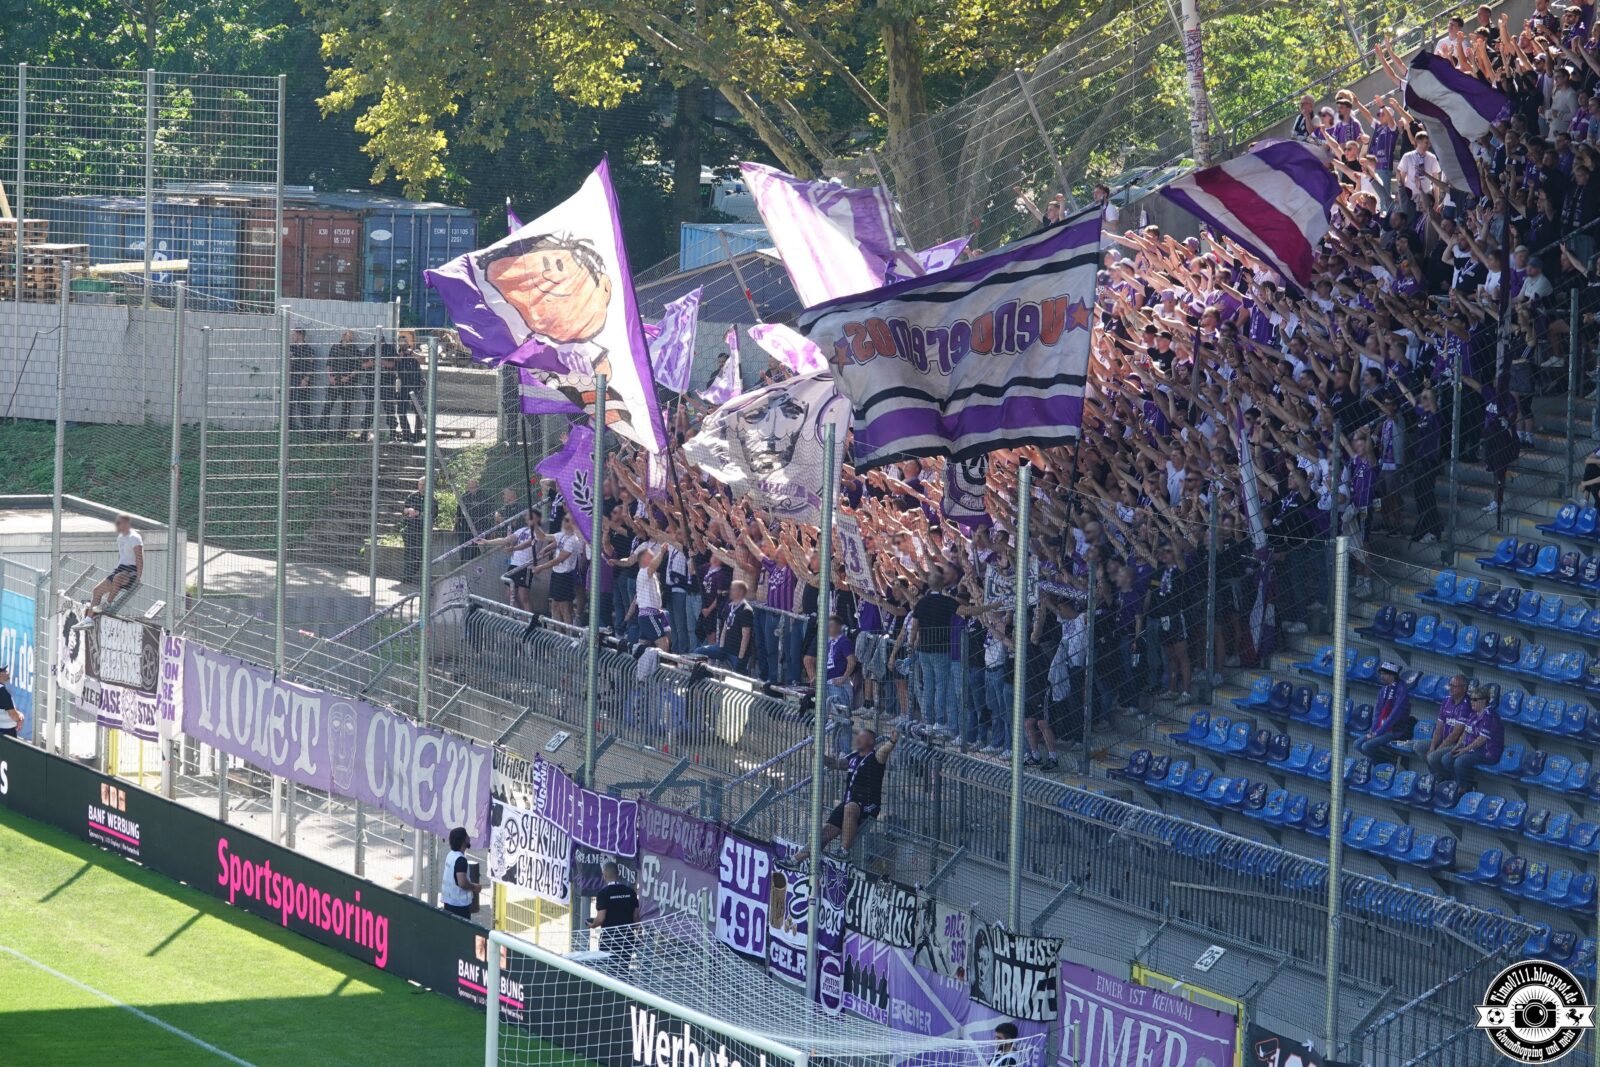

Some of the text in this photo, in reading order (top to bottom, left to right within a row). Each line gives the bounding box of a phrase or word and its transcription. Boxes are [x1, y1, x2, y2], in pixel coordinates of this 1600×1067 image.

[192, 650, 321, 776] VIOLET
[88, 804, 140, 840] BANF WERBUNG
[720, 836, 769, 895] SUP
[217, 837, 388, 968] Sportsponsoring
[458, 959, 524, 1002] BANF WBUNG
[1197, 949, 1220, 967] 25
[1096, 975, 1194, 1023] EIMER IST KEINMAL
